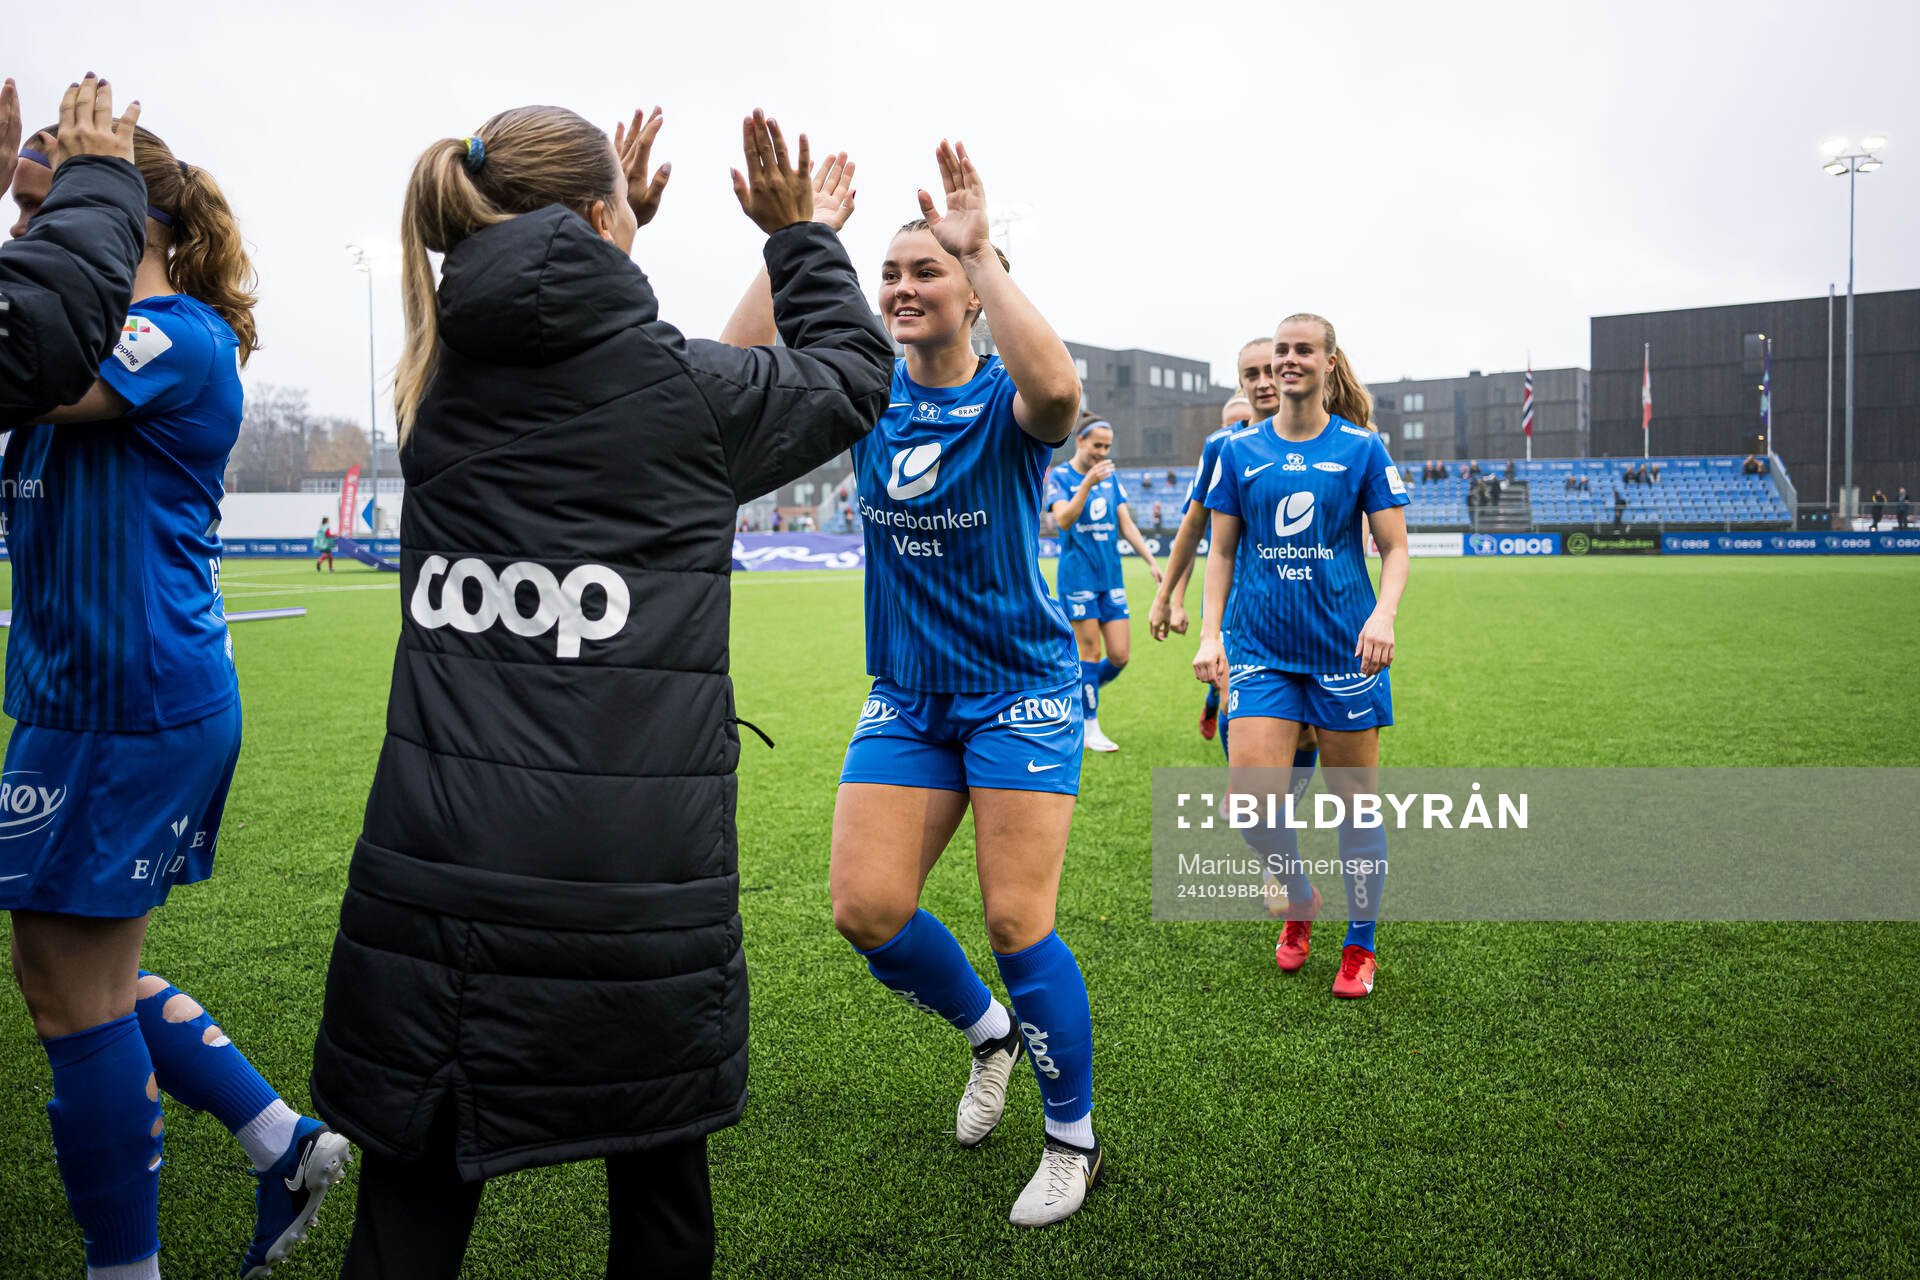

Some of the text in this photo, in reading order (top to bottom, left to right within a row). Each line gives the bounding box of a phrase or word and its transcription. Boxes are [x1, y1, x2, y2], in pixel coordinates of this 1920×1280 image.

[0, 471, 44, 498] nken
[892, 535, 943, 556] Vest
[1499, 538, 1553, 555] OBOS
[1681, 539, 1710, 549] OBOS
[1734, 539, 1763, 549] OBOS
[1787, 539, 1816, 549] OBOS
[1841, 539, 1871, 549] OBOS
[1277, 564, 1312, 580] Vest
[410, 554, 631, 658] coop
